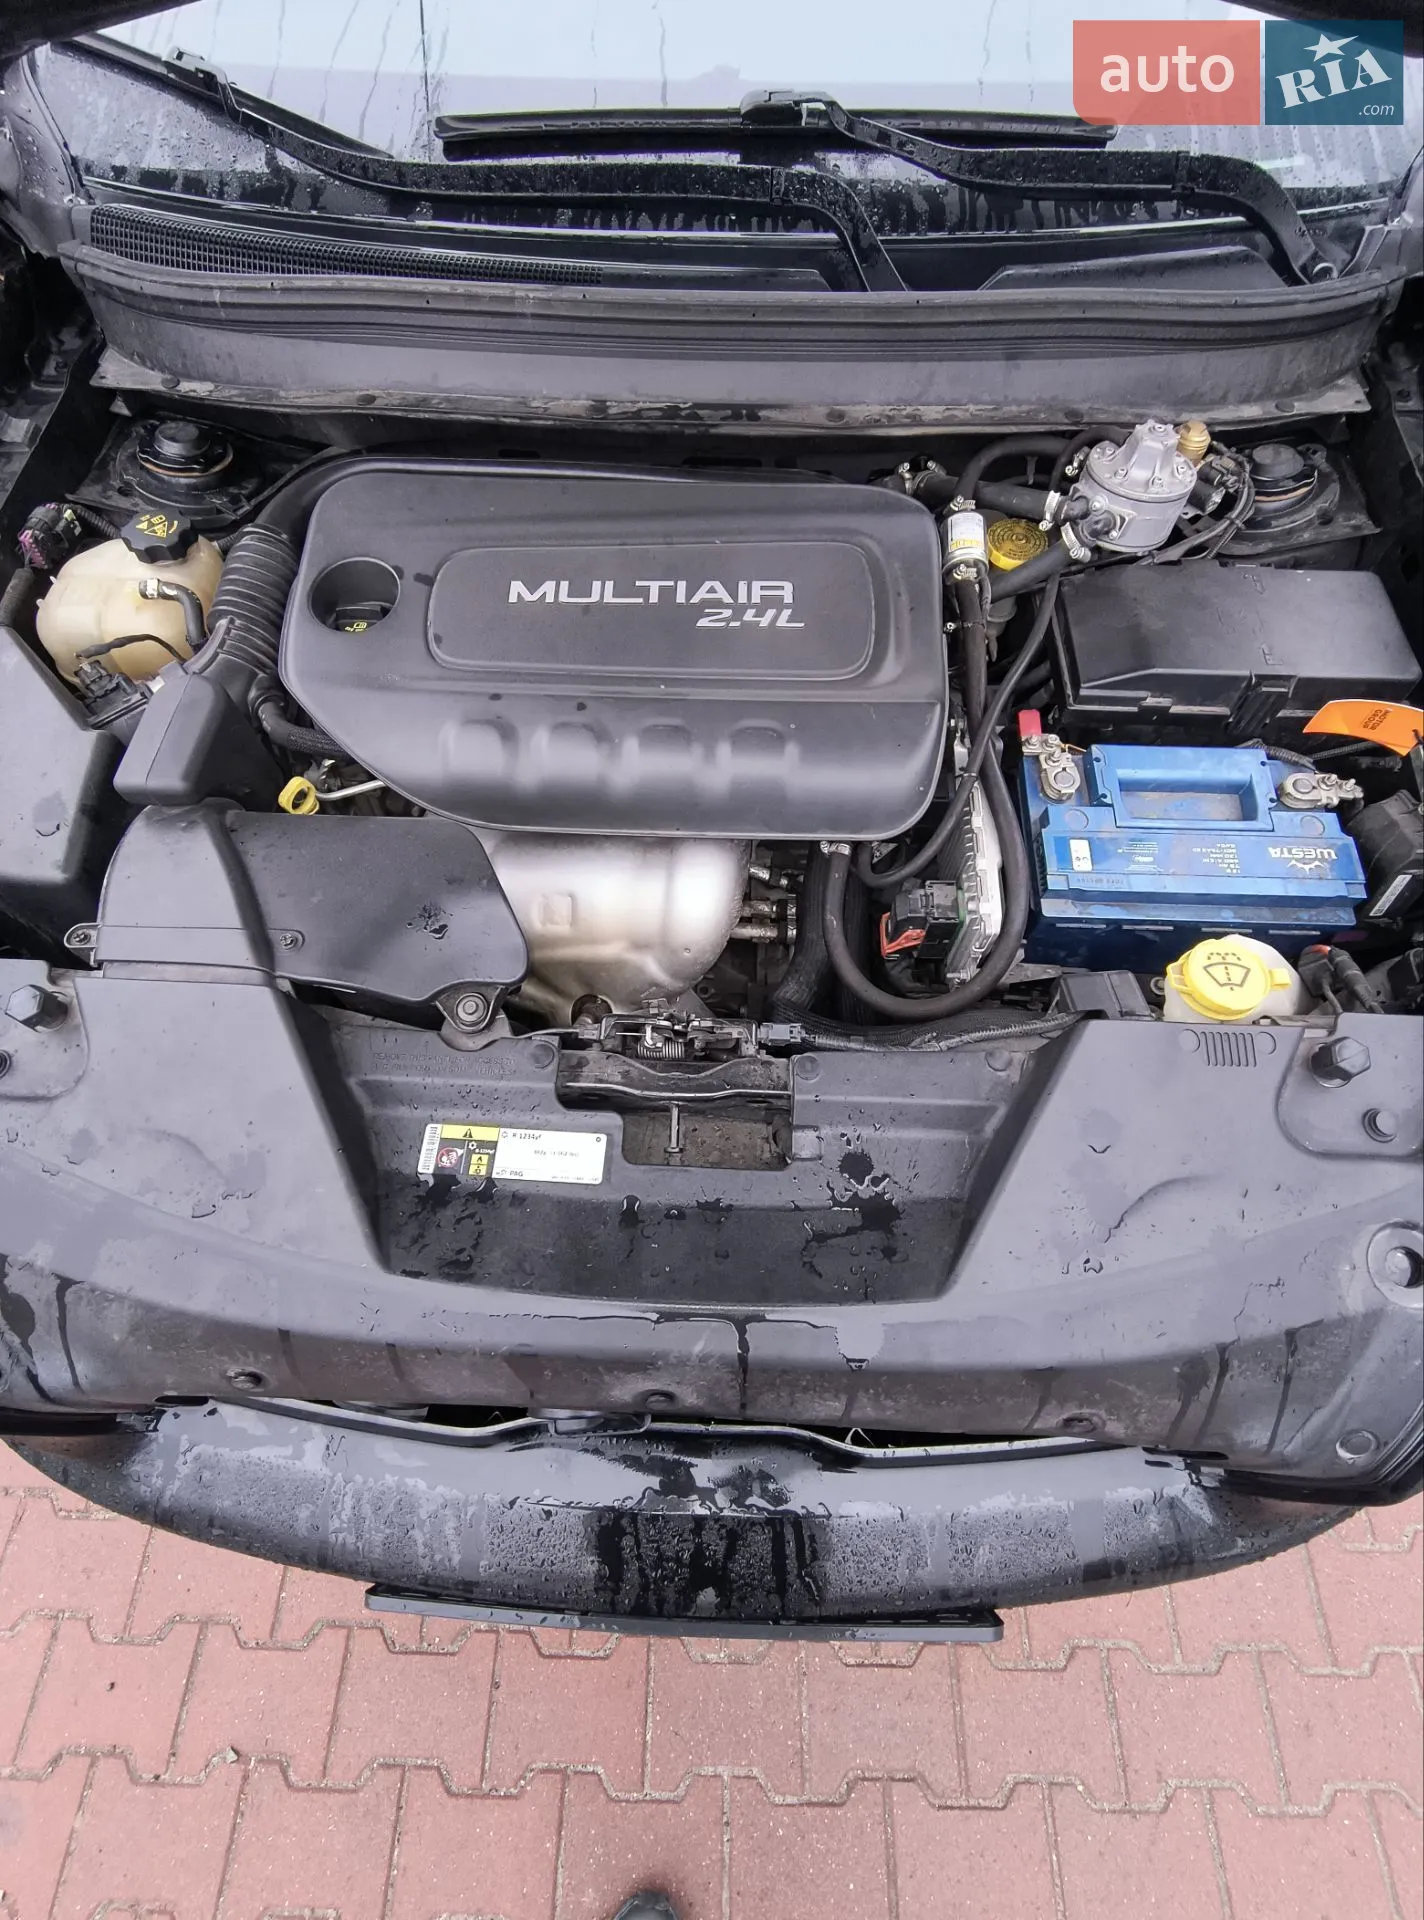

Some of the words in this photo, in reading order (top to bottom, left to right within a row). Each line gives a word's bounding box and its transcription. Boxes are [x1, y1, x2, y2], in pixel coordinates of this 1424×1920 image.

[508, 580, 794, 605] MULTIAIR
[695, 608, 806, 629] 2.4L
[1267, 847, 1338, 860] WESTA
